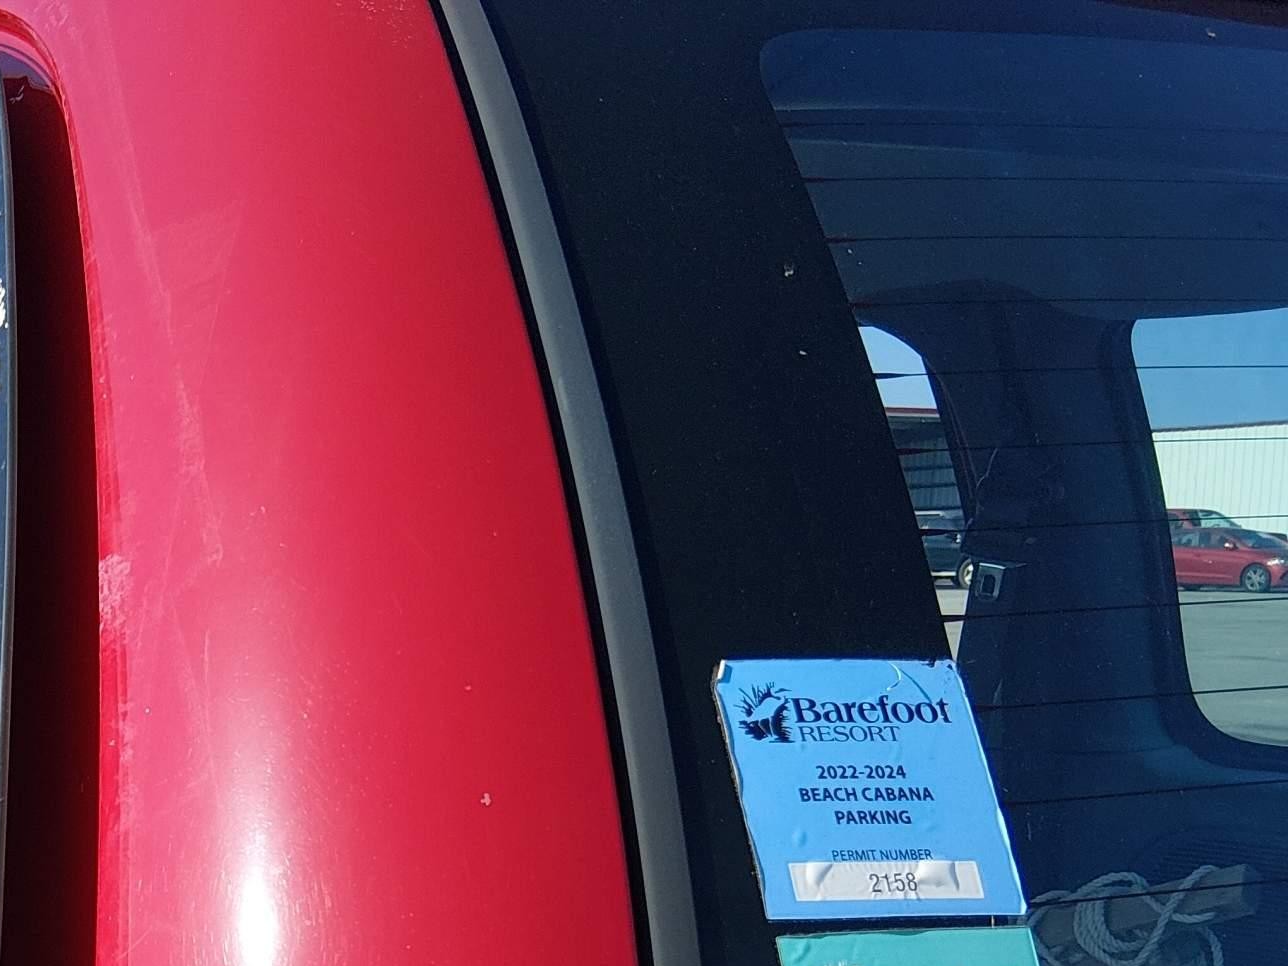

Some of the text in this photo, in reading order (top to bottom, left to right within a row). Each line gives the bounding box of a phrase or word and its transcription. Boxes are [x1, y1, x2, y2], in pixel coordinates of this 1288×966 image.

[790, 694, 952, 724] Barefoot
[799, 725, 901, 743] RESORT
[815, 765, 907, 780] 2022-2024
[799, 787, 935, 802] BEACH CABANA
[834, 810, 912, 825] PARKING
[831, 849, 934, 861] PERMIT NUMBER
[868, 873, 918, 893] 2158
